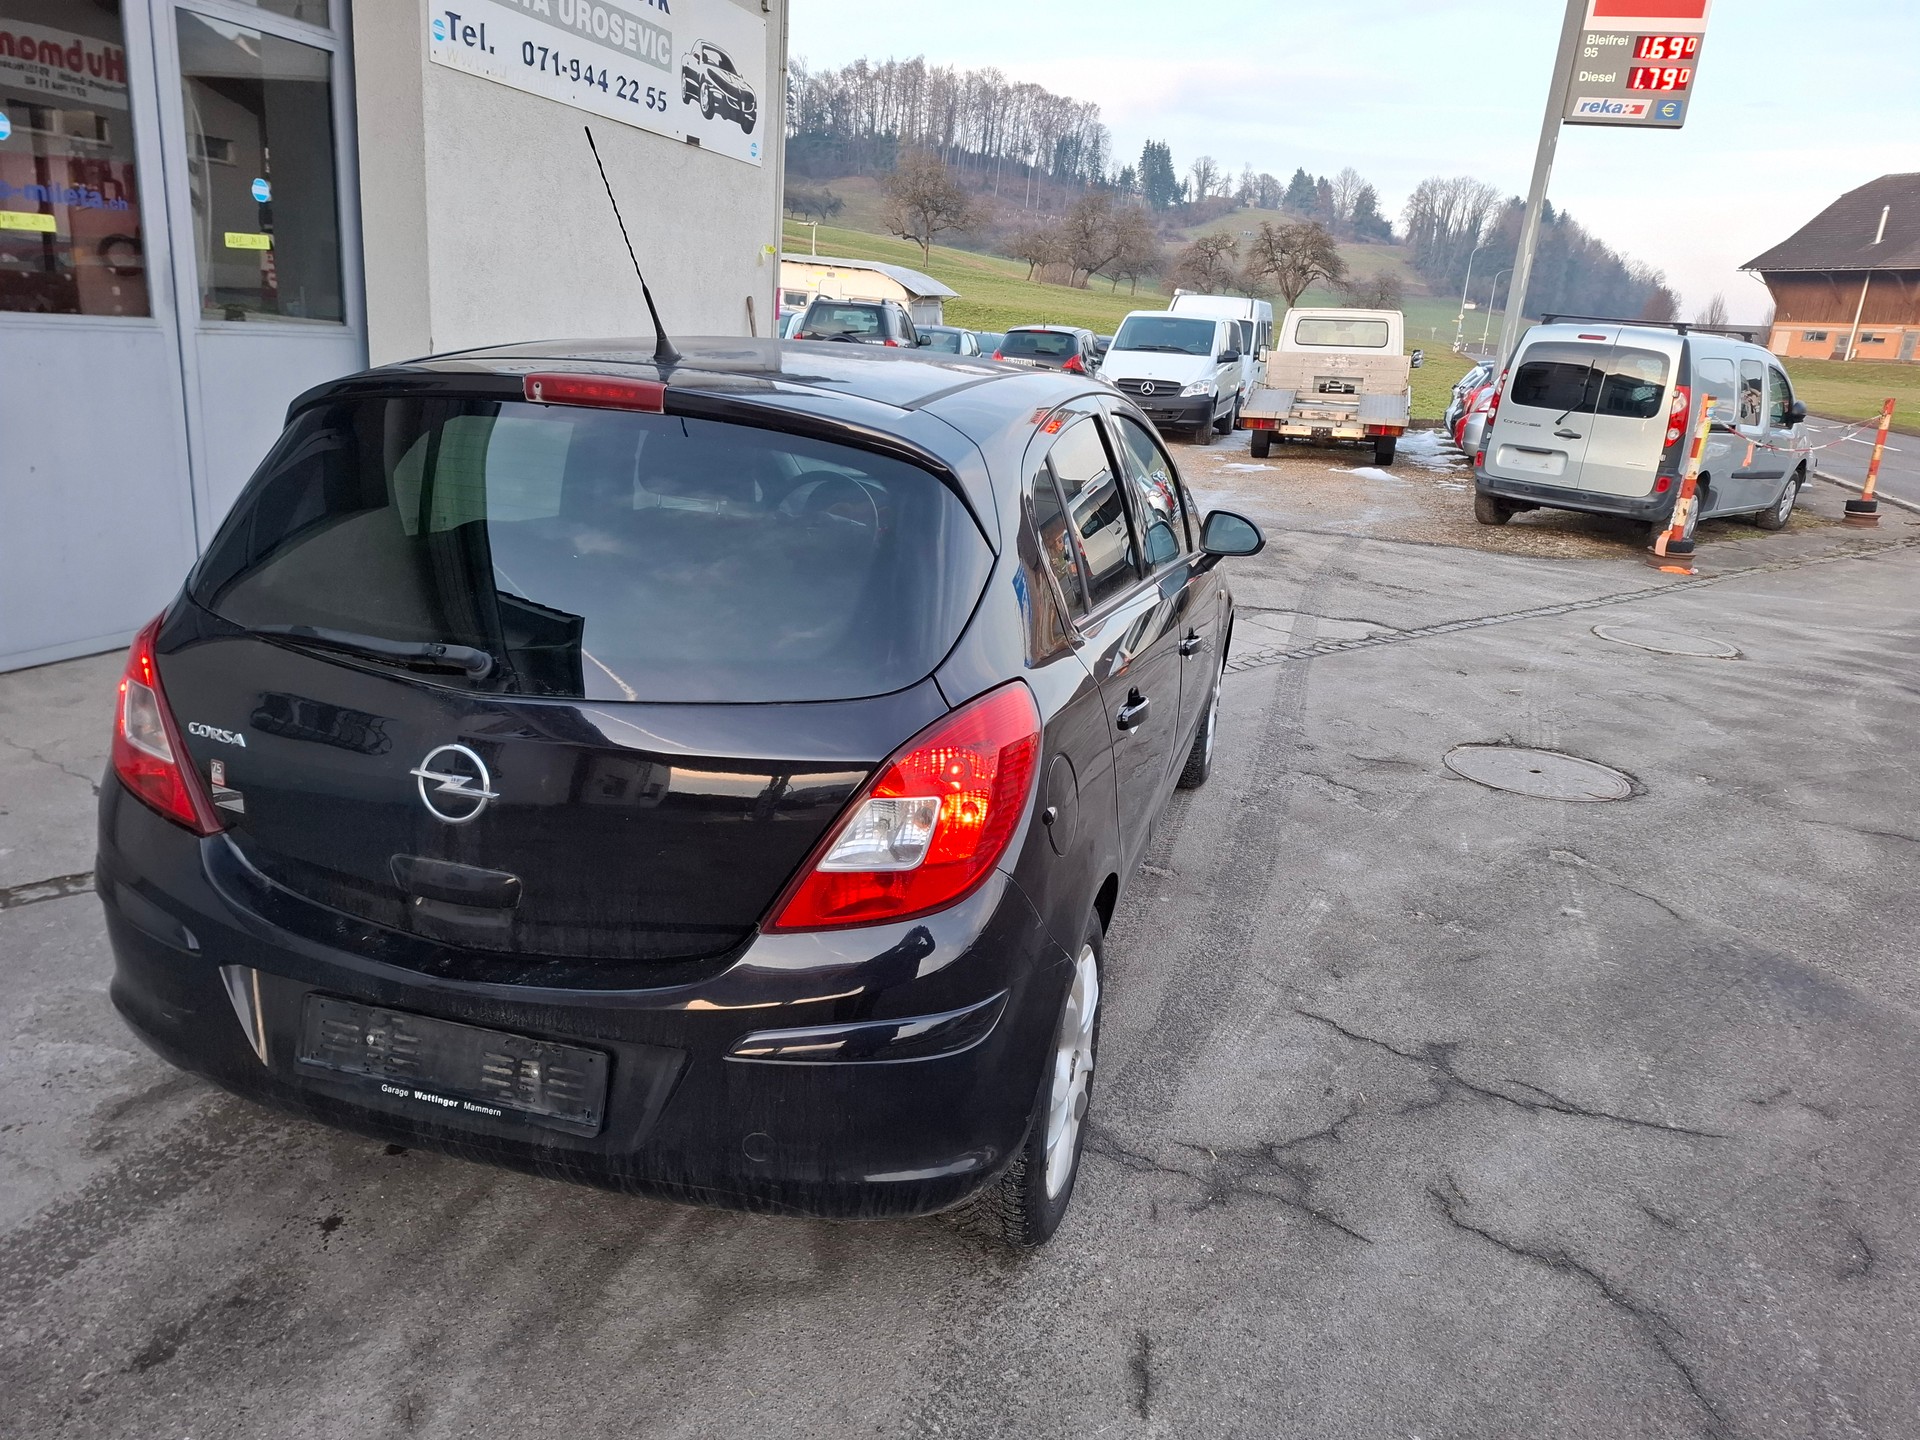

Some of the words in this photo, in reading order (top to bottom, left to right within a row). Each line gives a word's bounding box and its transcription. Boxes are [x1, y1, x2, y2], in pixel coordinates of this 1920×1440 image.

[558, 0, 671, 65] UROSEVIC
[1586, 34, 1629, 46] Bleifrei
[444, 11, 495, 54] Tel.
[521, 40, 608, 93] 071-944
[616, 75, 640, 104] 22
[646, 86, 668, 112] 55
[1583, 47, 1598, 58] 95
[1578, 71, 1616, 83] Diesel
[188, 722, 246, 748] CORSA
[381, 1083, 409, 1098] Garage
[413, 1090, 459, 1108] Wattinger
[463, 1101, 502, 1116] Mammern
